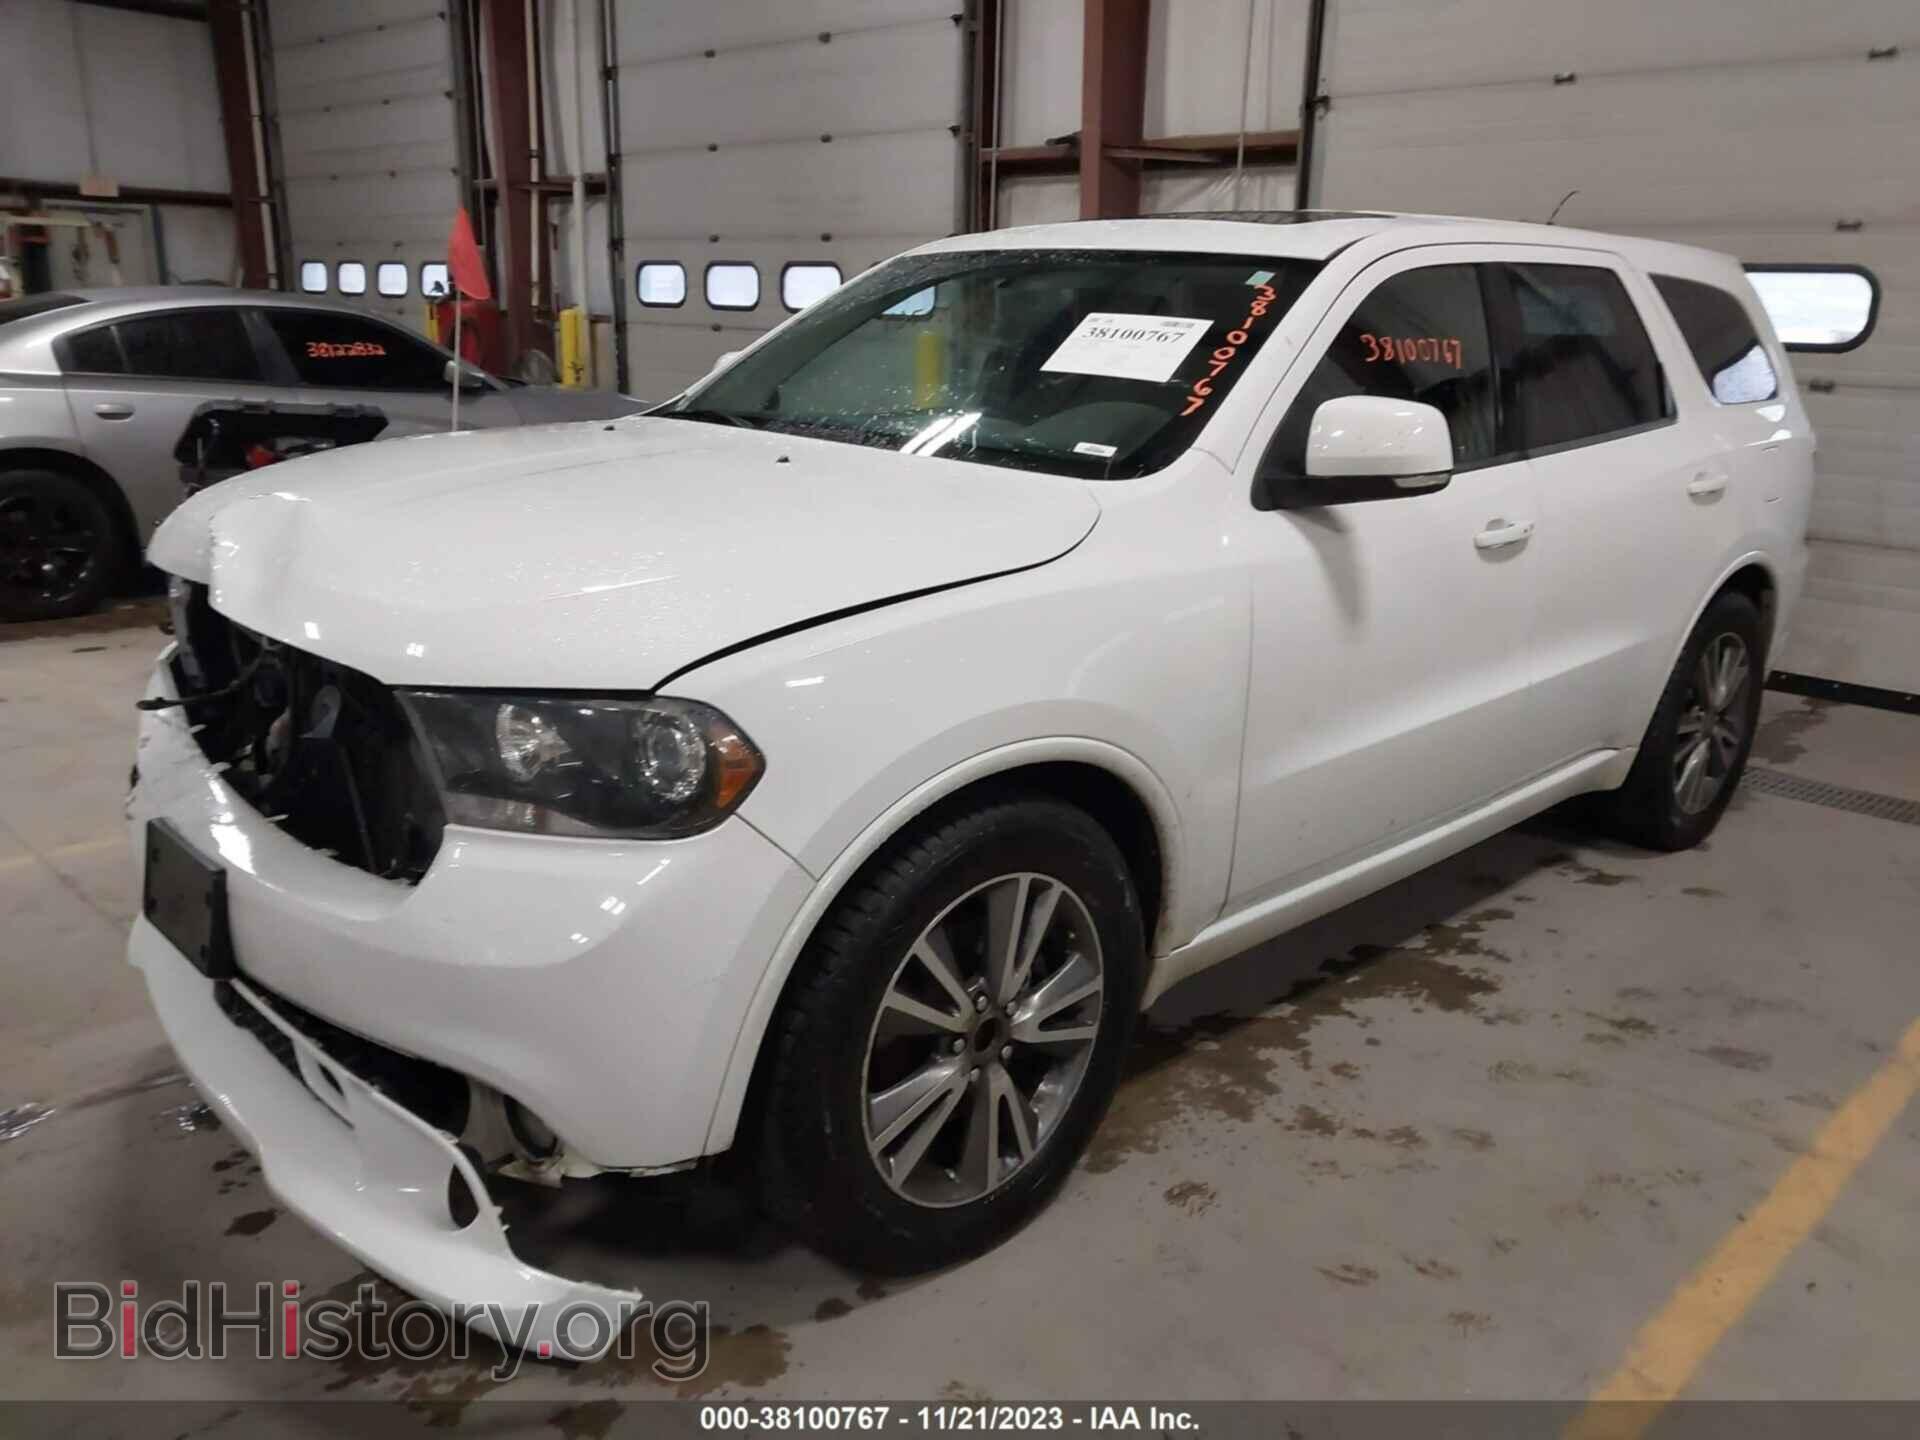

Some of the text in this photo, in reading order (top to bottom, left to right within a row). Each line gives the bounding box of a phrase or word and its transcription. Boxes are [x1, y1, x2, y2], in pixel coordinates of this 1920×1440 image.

[1082, 326, 1185, 344] 38100767
[1179, 284, 1276, 416] 38100767
[1360, 334, 1462, 369] 38100767
